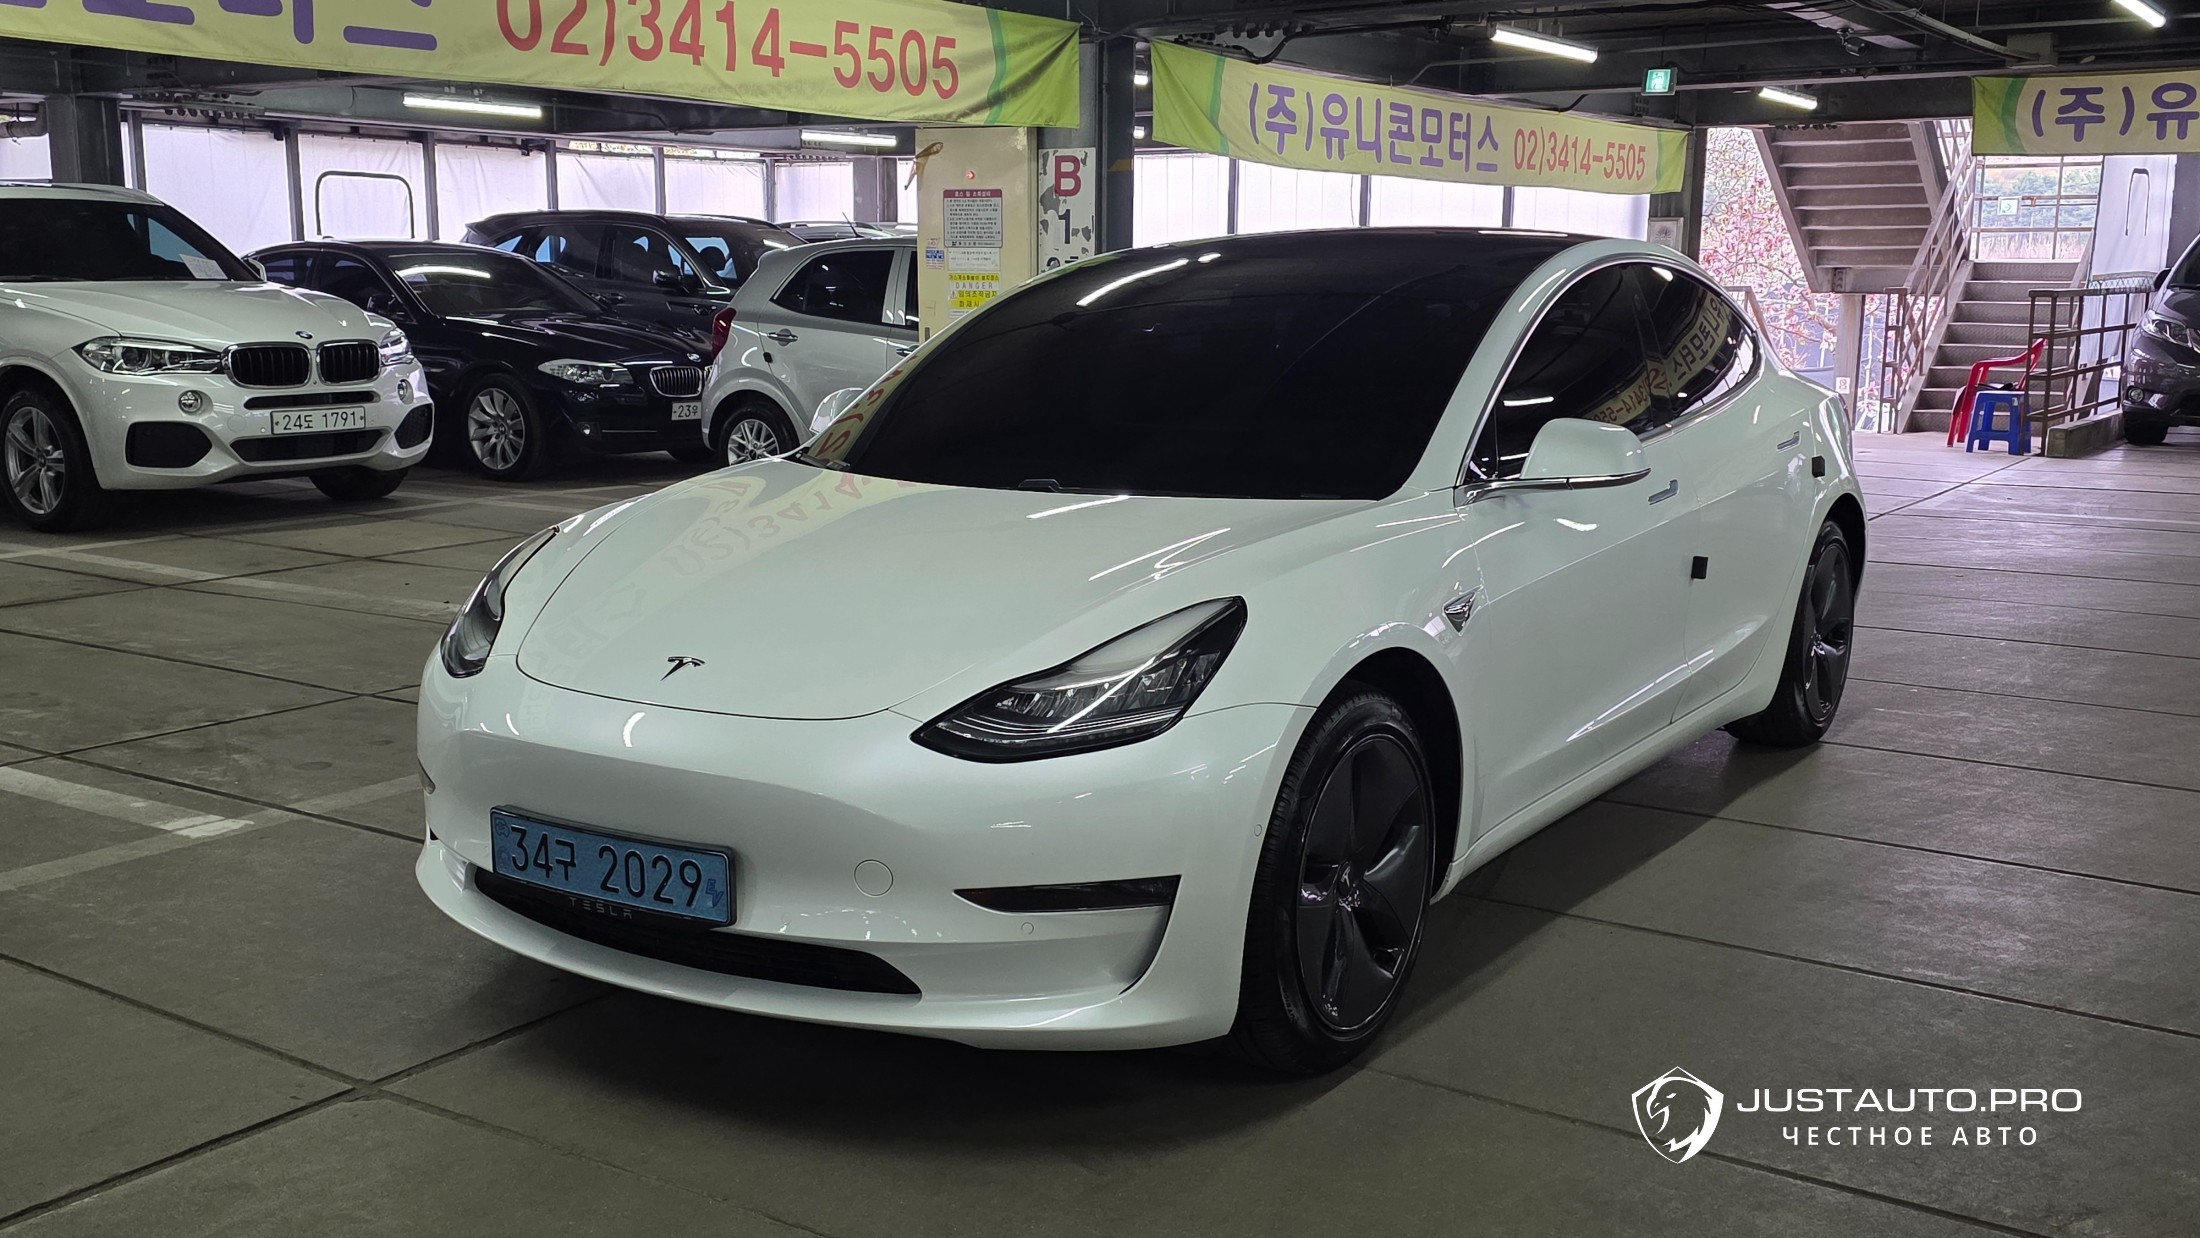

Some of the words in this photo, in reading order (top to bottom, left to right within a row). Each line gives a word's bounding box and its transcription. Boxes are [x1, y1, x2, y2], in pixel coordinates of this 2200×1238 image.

[497, 0, 959, 99] 02)3414-5505
[1249, 82, 1499, 172] (주)유니콘모터스
[1514, 126, 1646, 181] 02)3414-5505
[2032, 86, 2200, 142] (주)유
[1054, 155, 1081, 197] B
[283, 414, 313, 430] 24도
[322, 411, 356, 428] 1791
[678, 404, 698, 418] 23우
[511, 825, 576, 881] 34구
[599, 845, 702, 907] 2029
[569, 896, 632, 920] TESLA
[705, 878, 725, 908] EV
